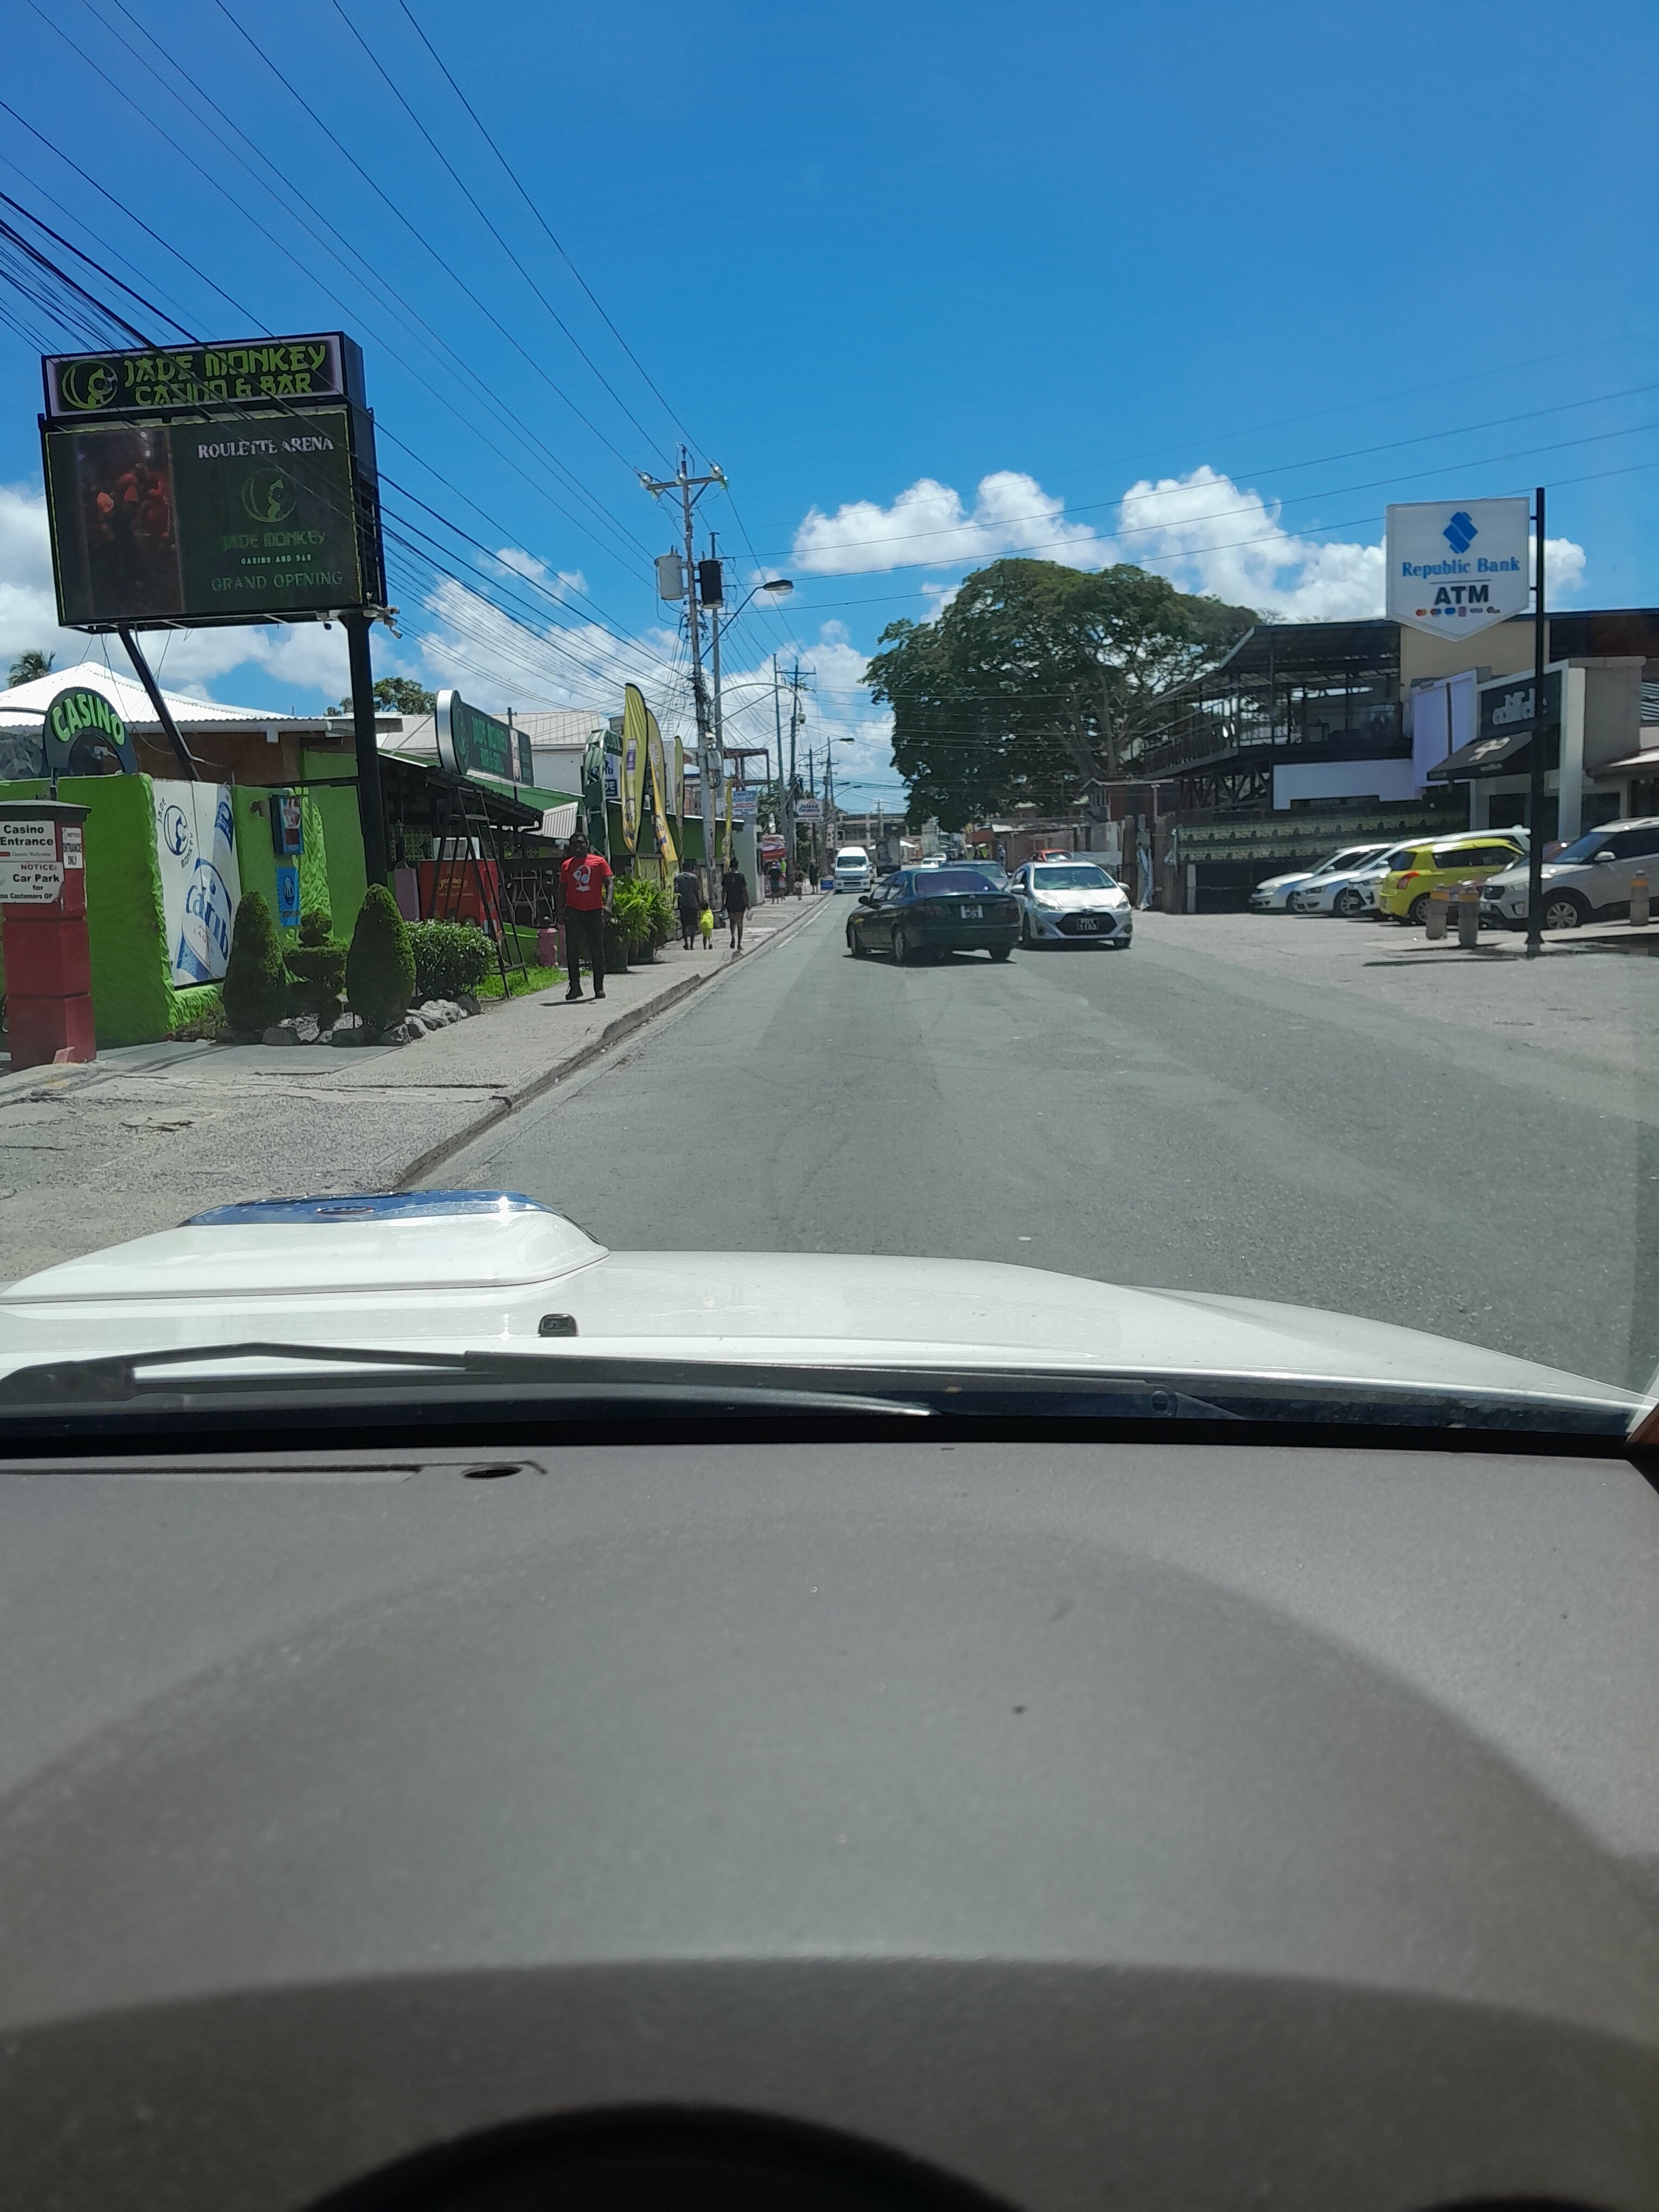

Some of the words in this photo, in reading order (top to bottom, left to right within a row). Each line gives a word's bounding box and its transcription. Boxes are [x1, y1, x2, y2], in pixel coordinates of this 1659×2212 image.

[124, 355, 195, 387] JADE
[205, 345, 325, 377] MONKEY
[135, 379, 227, 406] CASINO
[236, 378, 252, 398] &
[260, 372, 312, 397] BAR
[197, 439, 278, 459] ROULETTE
[281, 436, 335, 453] ARENA
[263, 530, 326, 548] MONKEY
[241, 557, 271, 565] CASINO
[275, 555, 292, 563] AND
[296, 554, 312, 562] BAR
[1402, 559, 1471, 580] Republic
[1477, 556, 1520, 573] Bank
[211, 575, 268, 592] GRAND
[273, 571, 343, 589] OPENING
[1433, 584, 1490, 606] ATM
[50, 693, 125, 746] CASINO
[3, 825, 44, 834] Casino
[0, 837, 53, 846] Entrance
[12, 873, 31, 883] Car
[35, 874, 60, 883] Park
